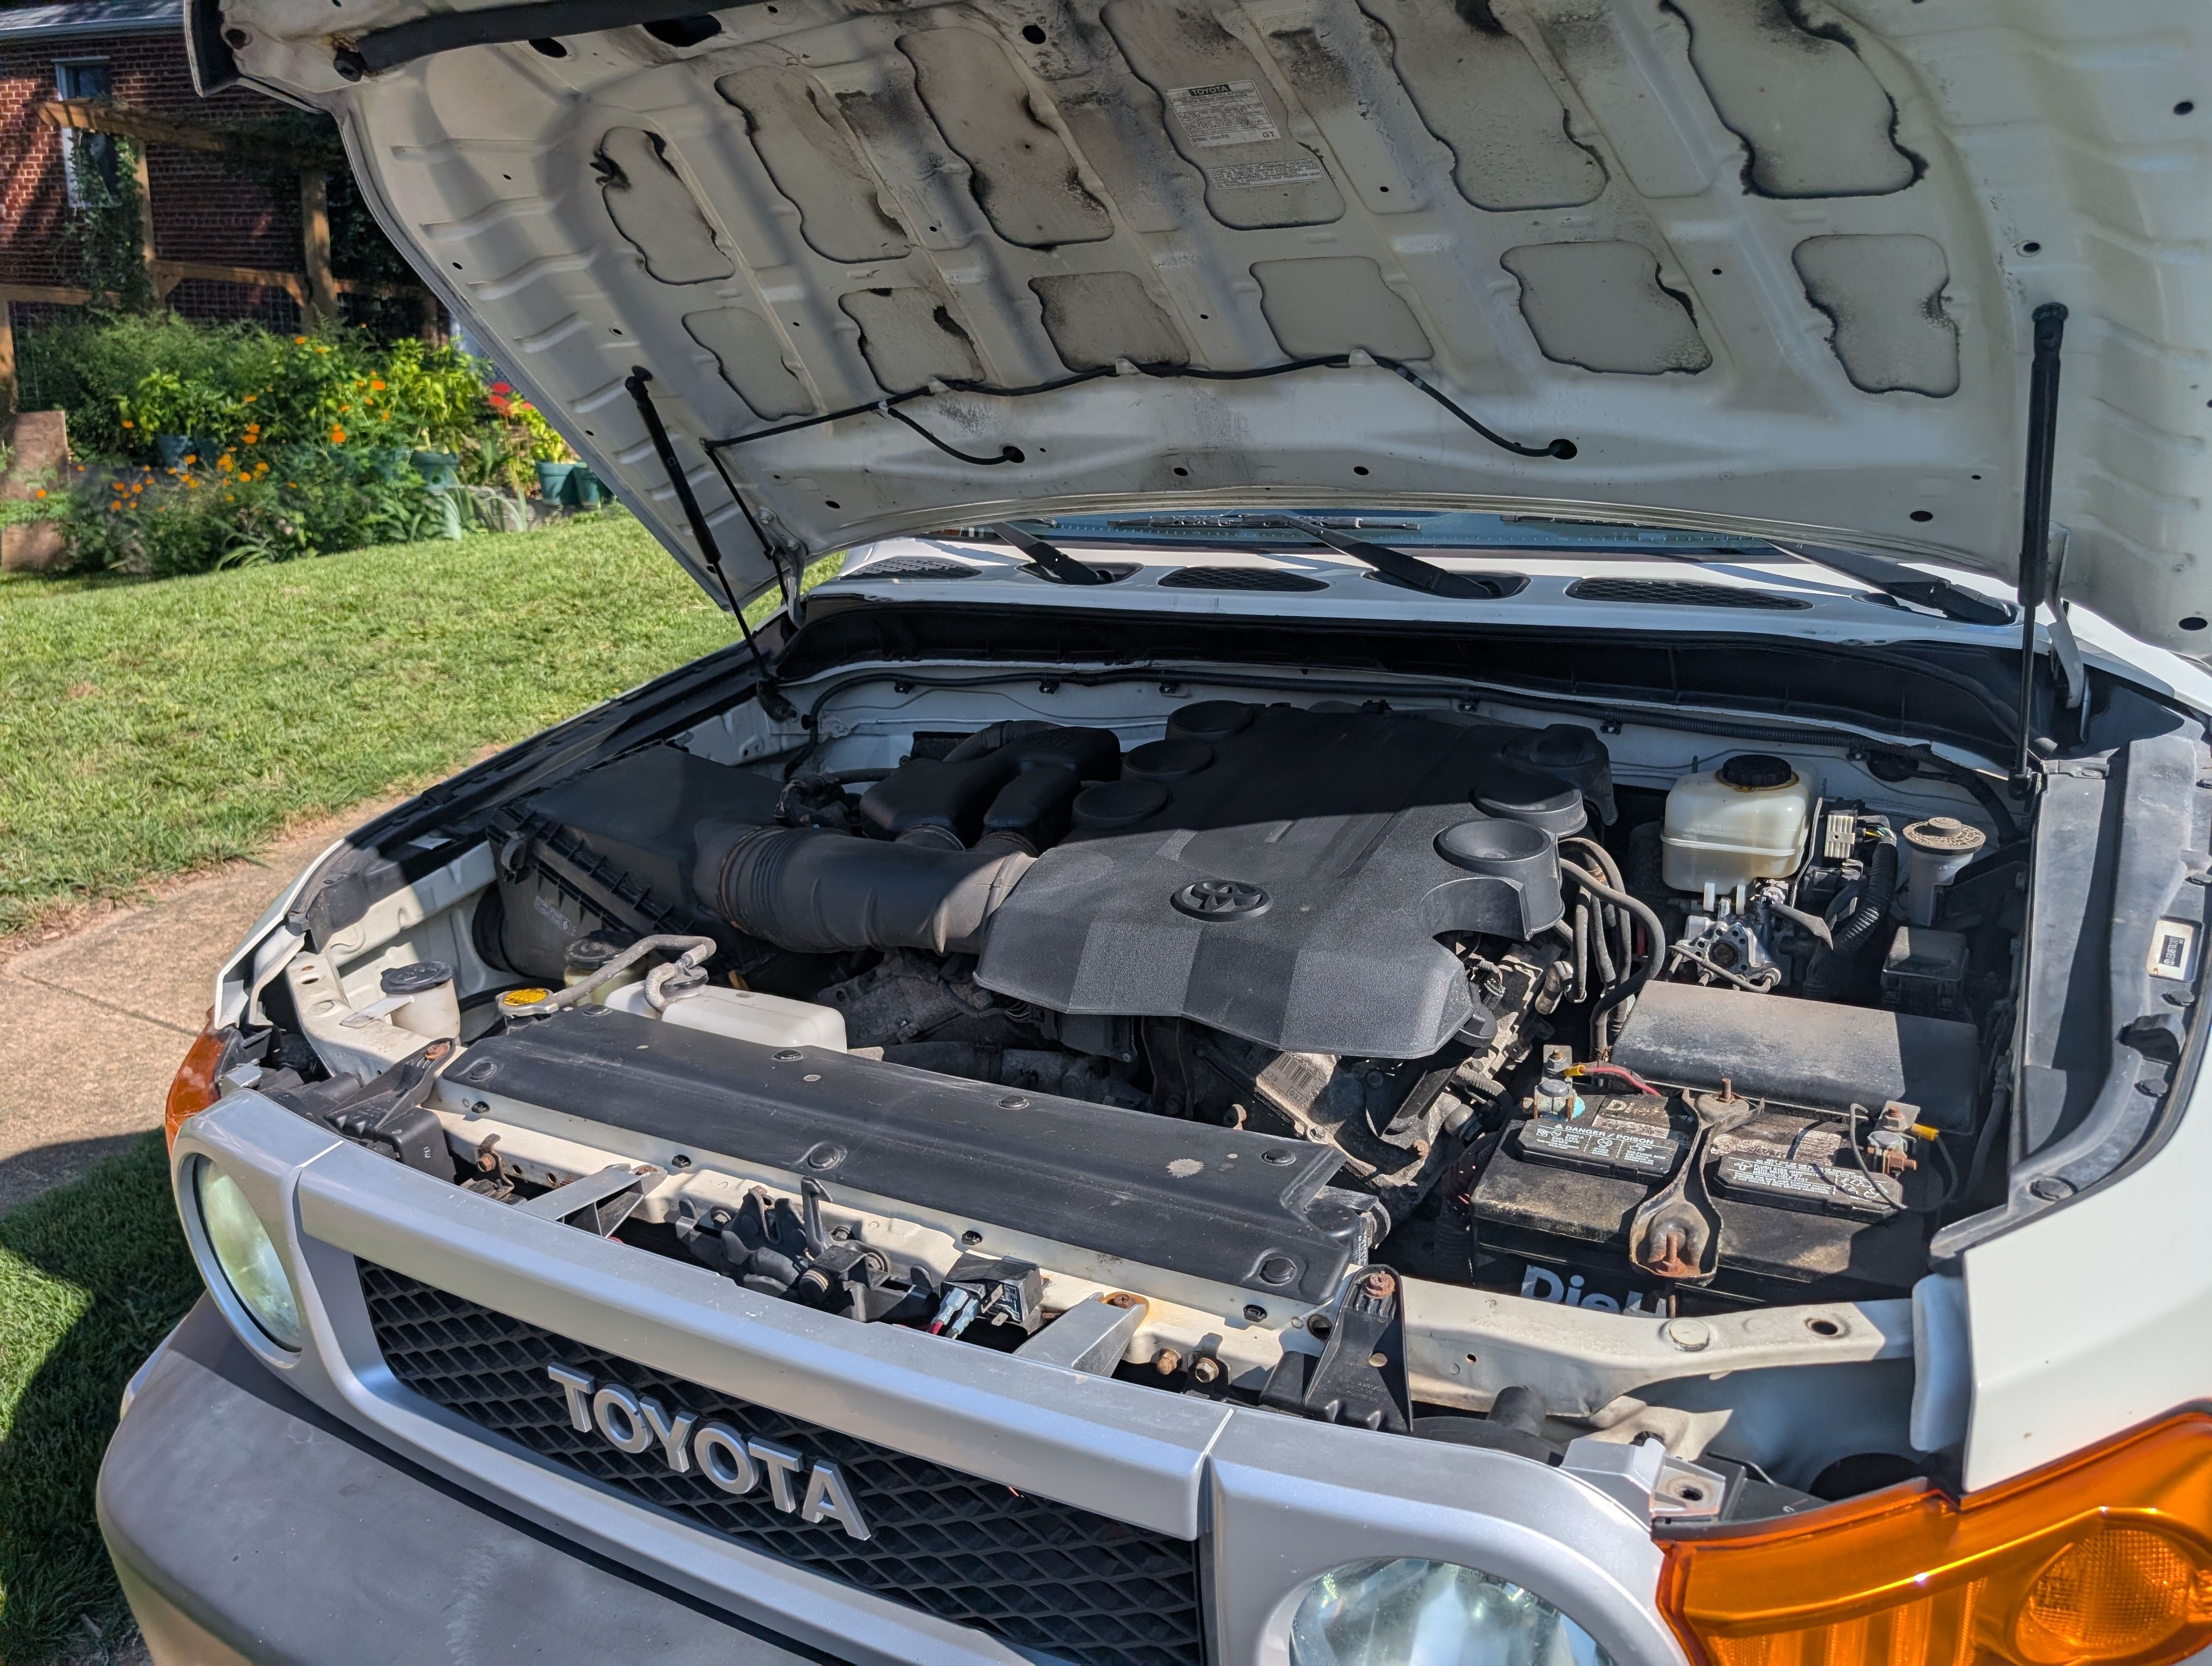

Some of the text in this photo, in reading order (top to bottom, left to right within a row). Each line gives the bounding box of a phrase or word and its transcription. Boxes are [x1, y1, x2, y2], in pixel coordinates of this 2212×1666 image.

[1191, 86, 1228, 95] TOYOTA
[1289, 1090, 1302, 1102] 037
[1565, 1125, 1606, 1137] DANGER
[1616, 1134, 1654, 1145] POISON
[548, 1361, 871, 1541] TOYOTA
